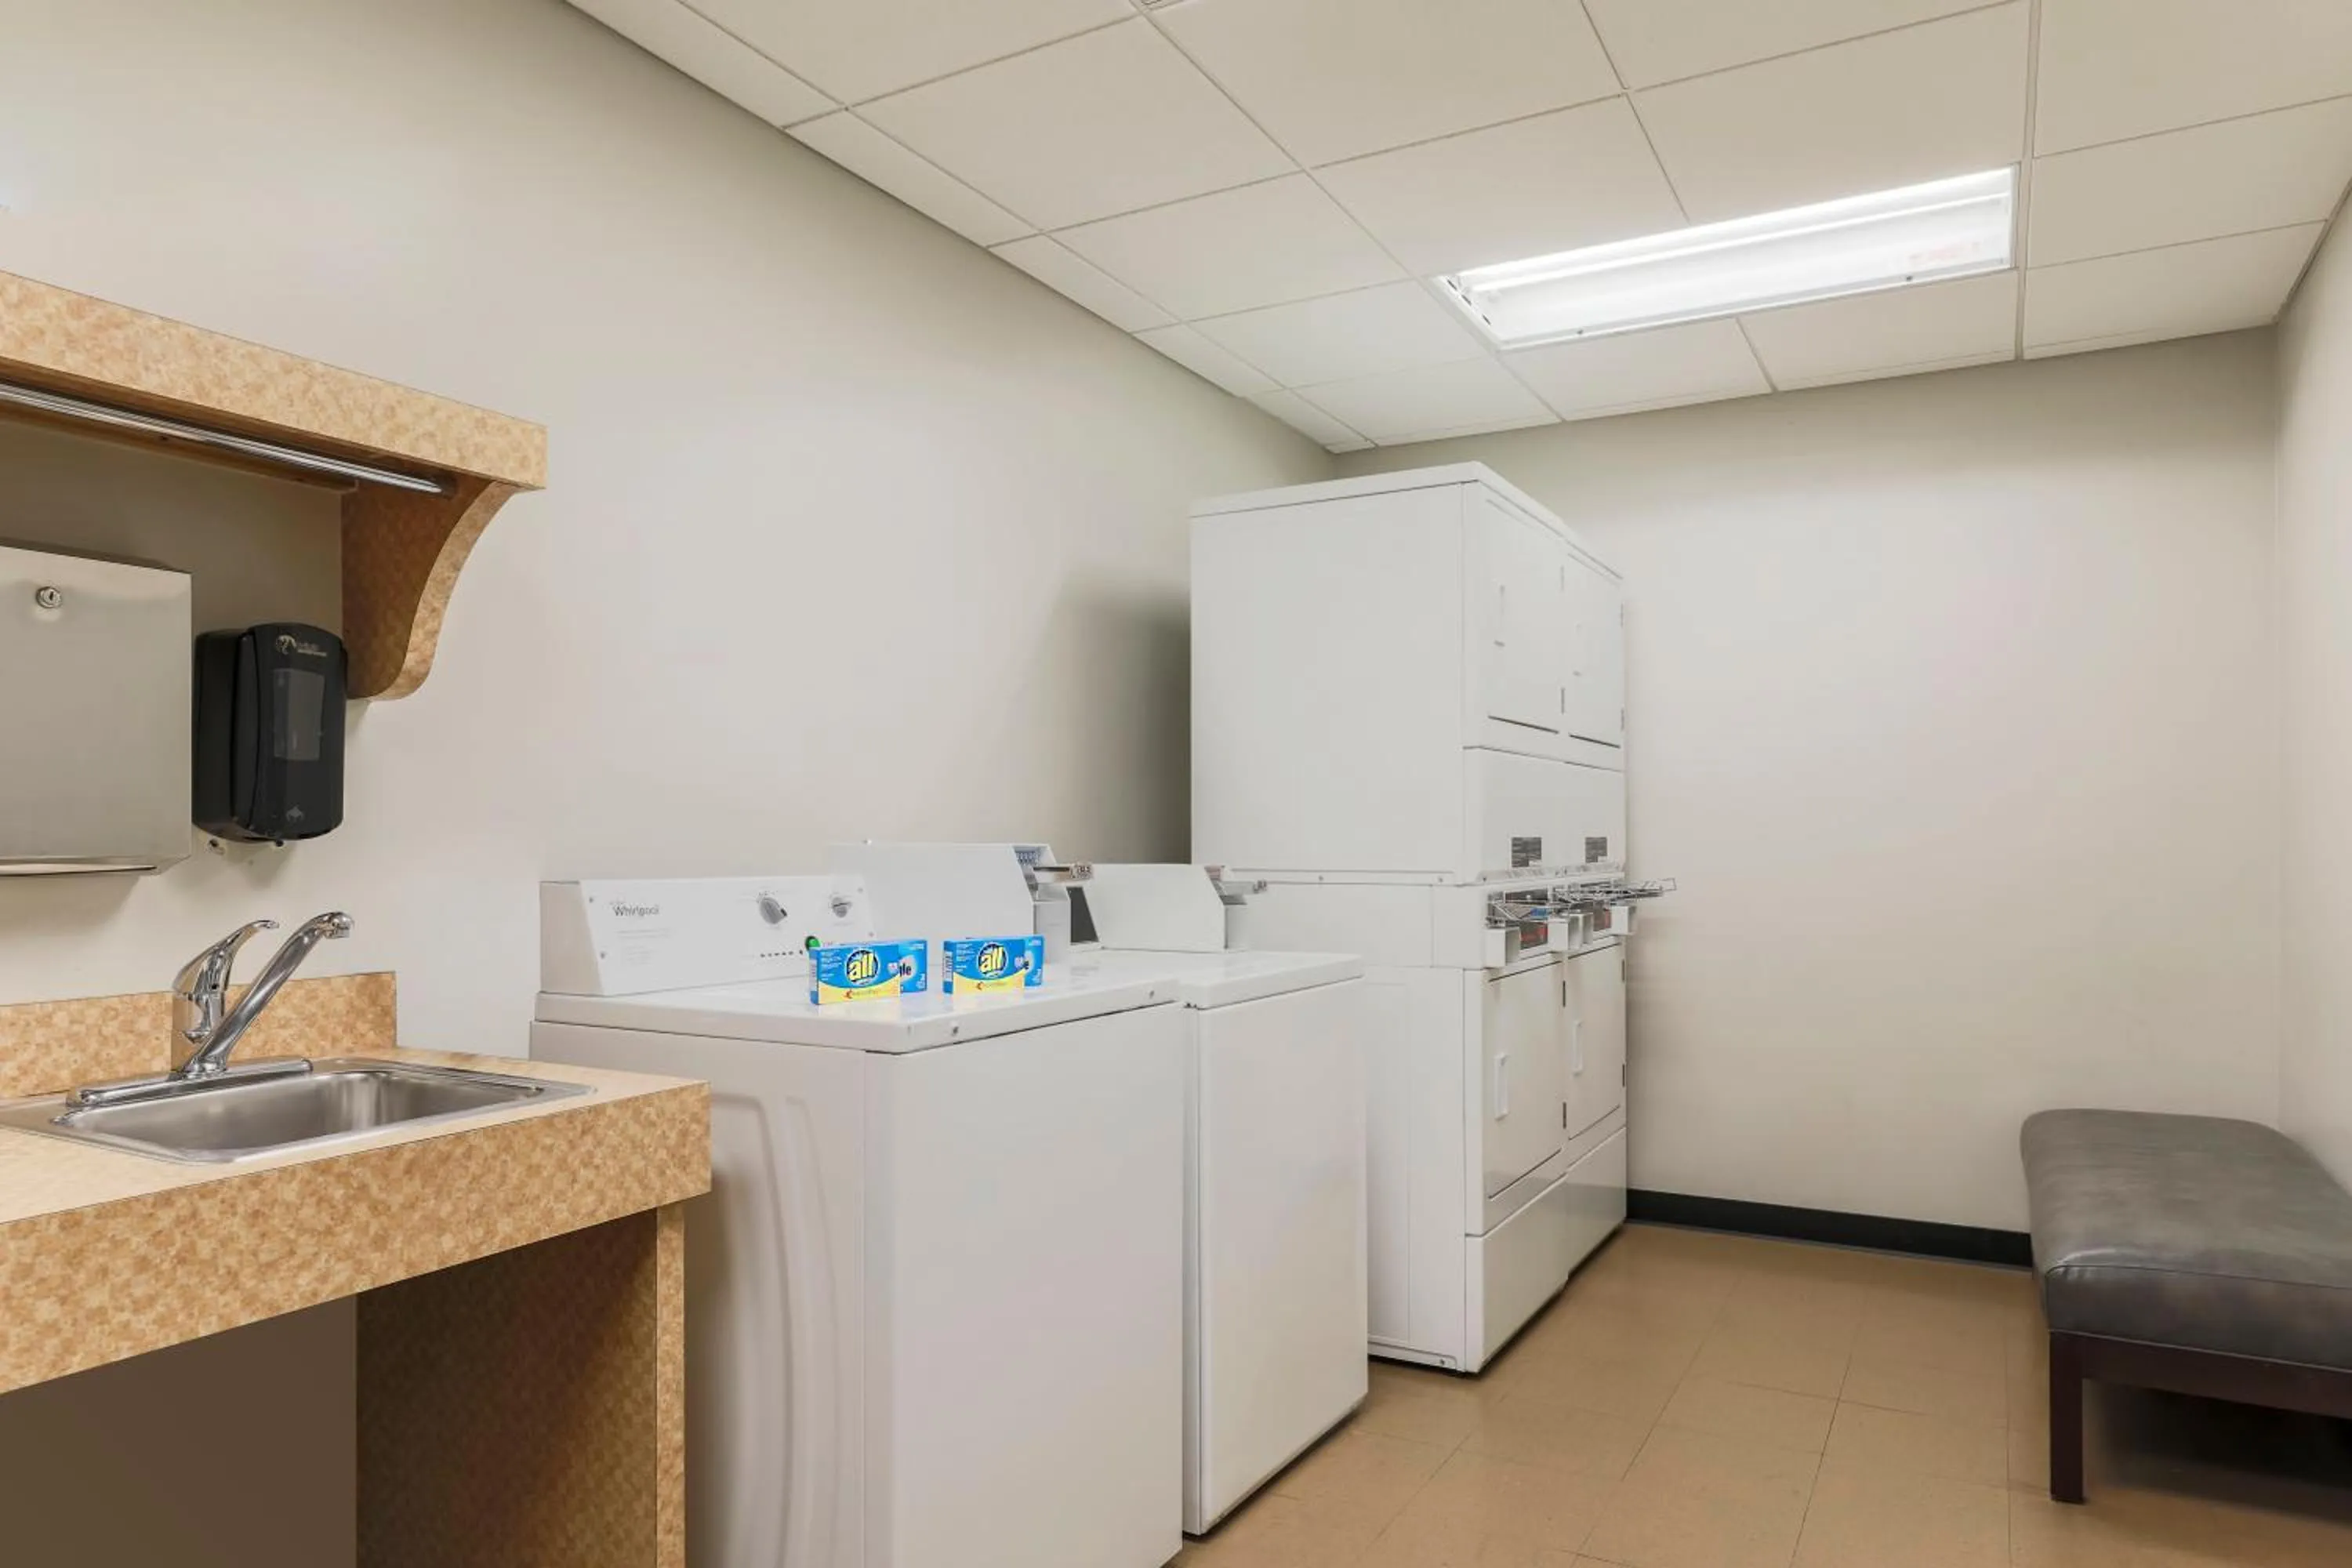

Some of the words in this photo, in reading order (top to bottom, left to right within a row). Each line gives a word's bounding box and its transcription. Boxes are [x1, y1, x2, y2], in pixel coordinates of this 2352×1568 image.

[612, 904, 660, 916] Whirlpool
[849, 953, 874, 981] all
[980, 946, 1004, 973] all
